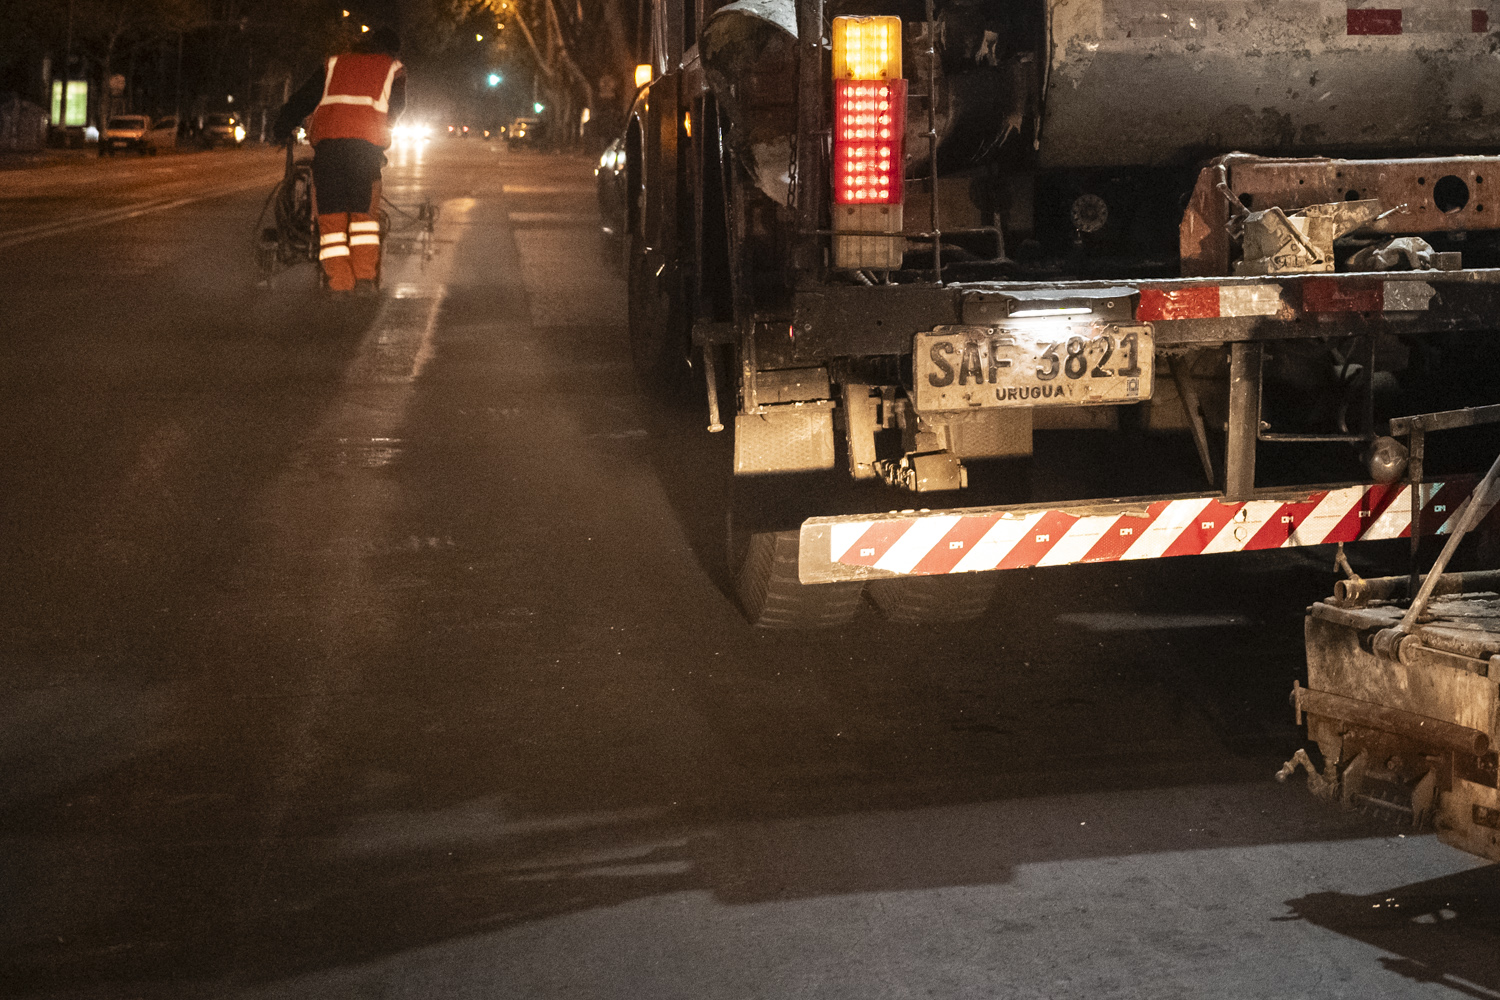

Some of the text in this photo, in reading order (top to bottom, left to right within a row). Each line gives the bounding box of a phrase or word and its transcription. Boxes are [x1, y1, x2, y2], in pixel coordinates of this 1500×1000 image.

[928, 332, 1142, 388] SAF 3821
[996, 384, 1074, 401] URUGUAY
